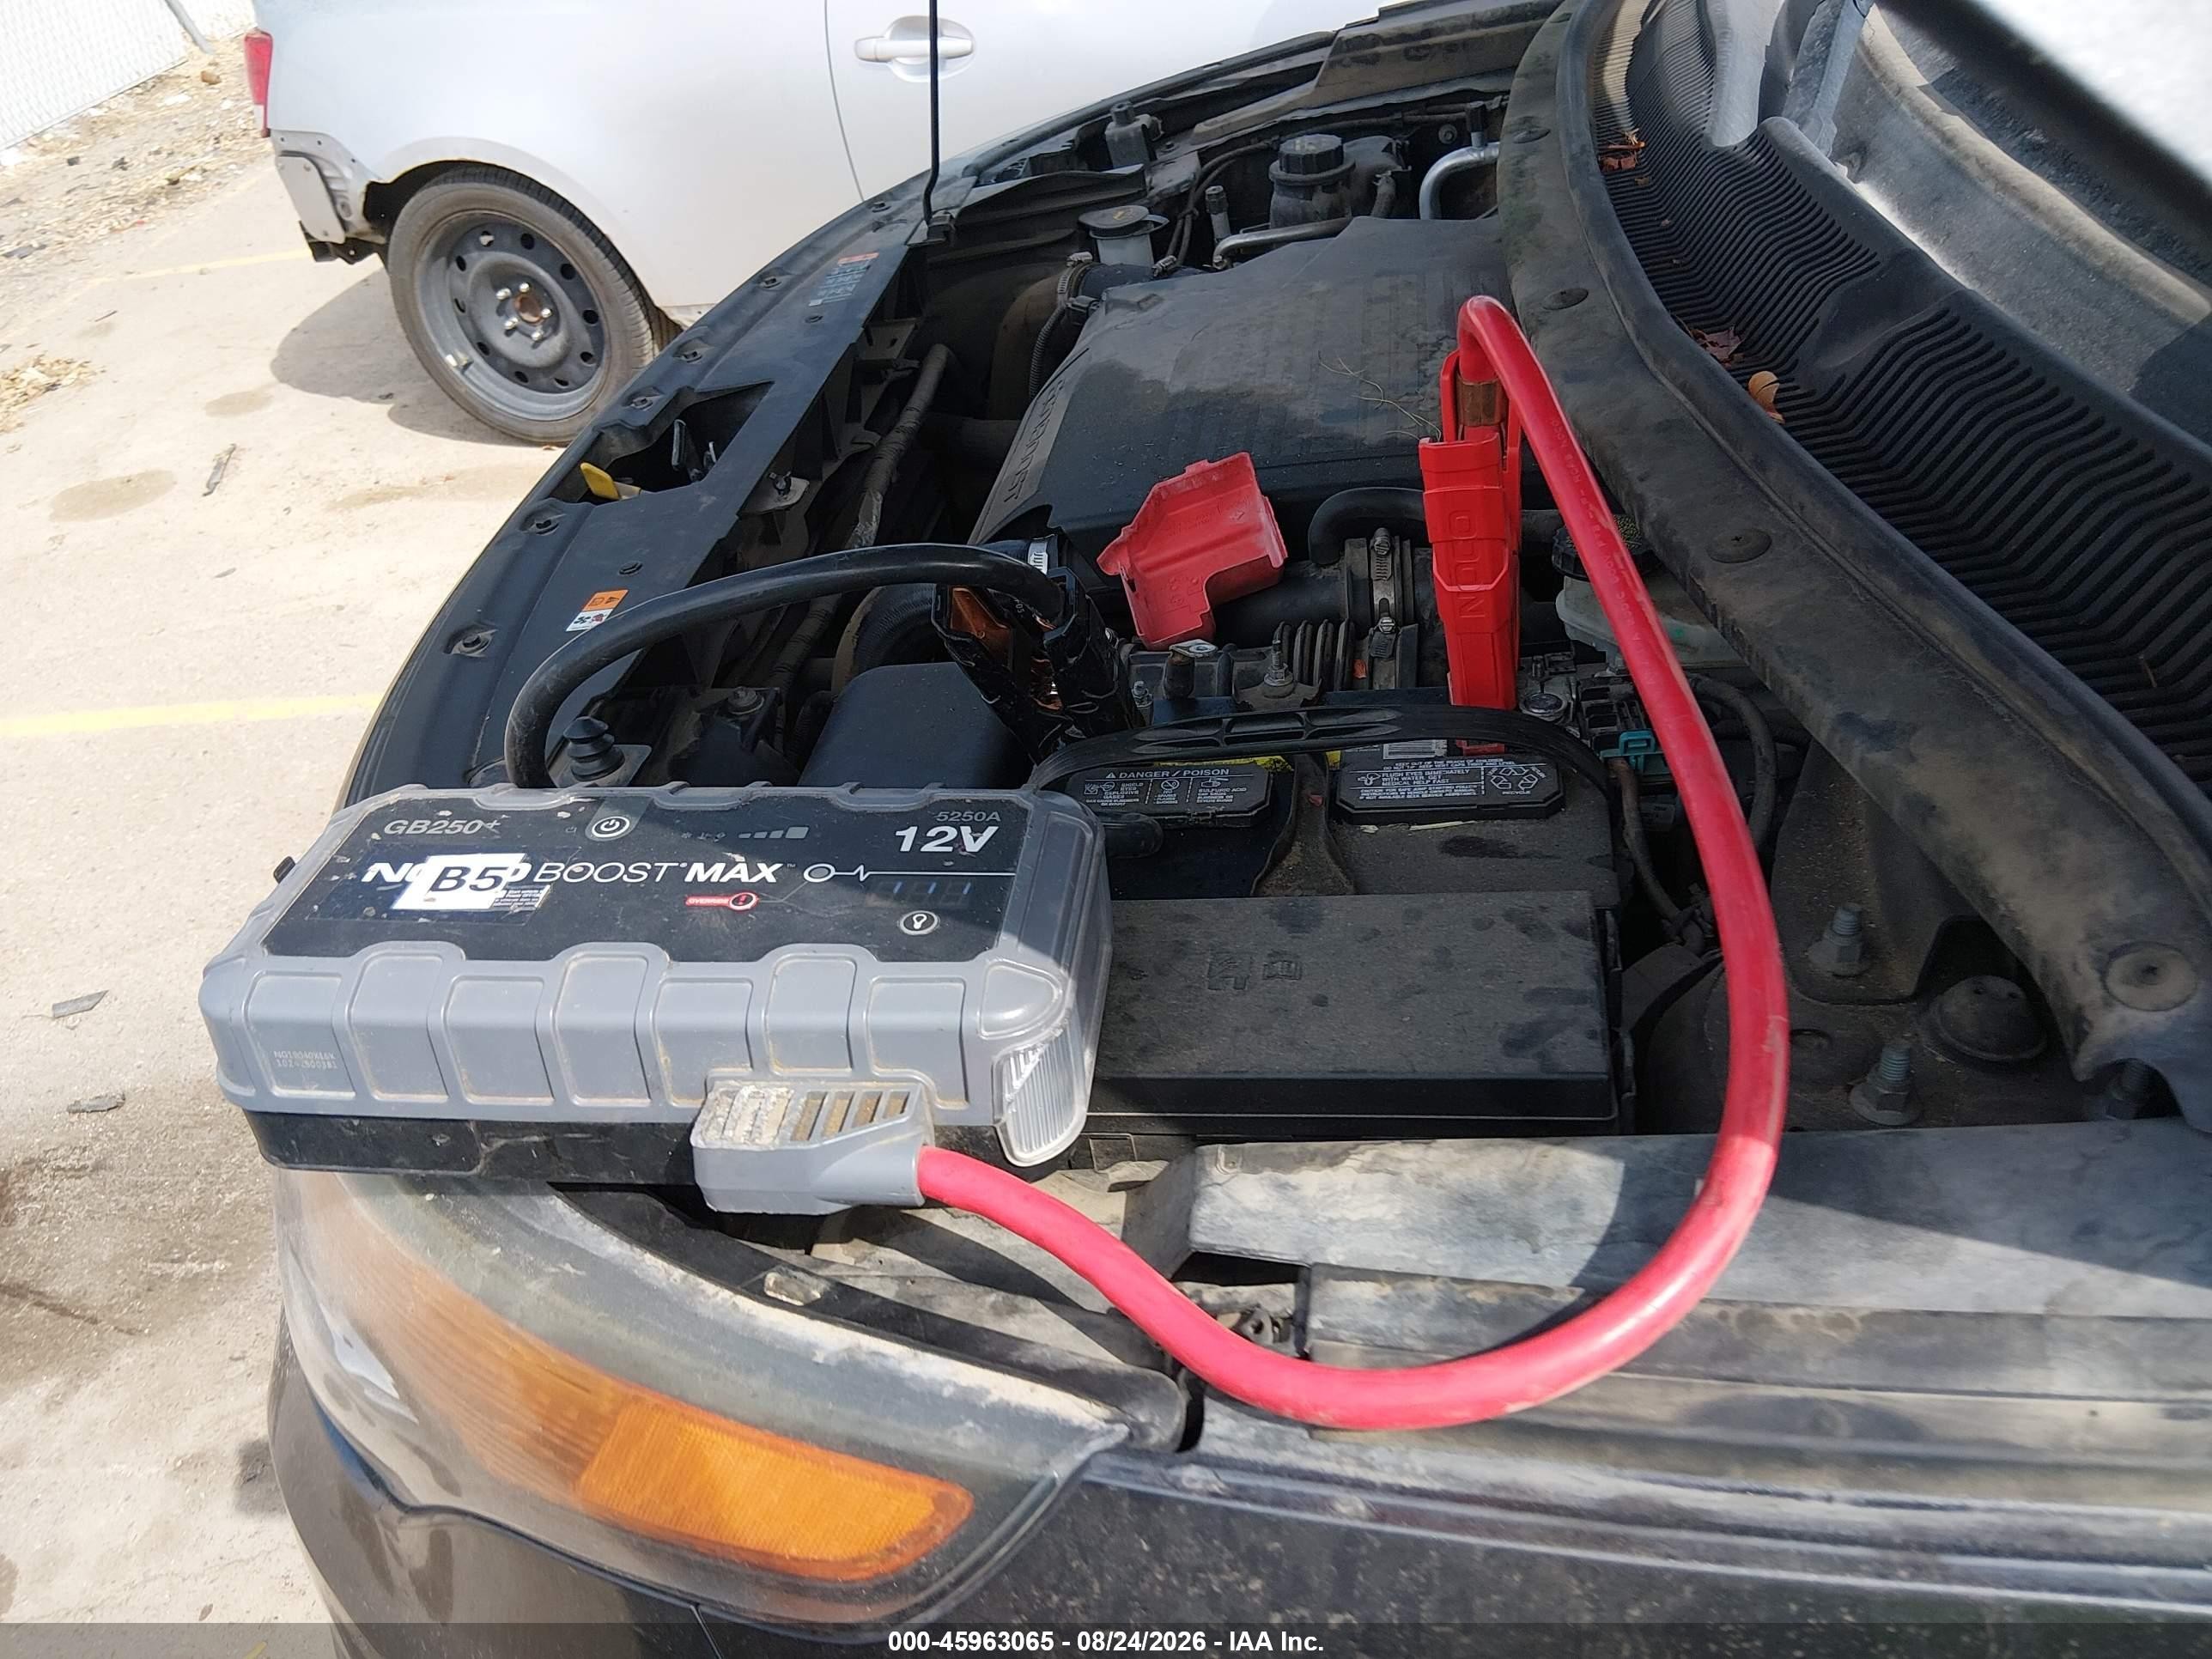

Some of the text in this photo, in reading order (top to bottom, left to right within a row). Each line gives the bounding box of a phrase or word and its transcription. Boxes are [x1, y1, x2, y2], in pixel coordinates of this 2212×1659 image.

[1119, 770, 1170, 779] DANGER
[936, 811, 1001, 823] 5250A
[894, 825, 999, 853] 12V
[429, 866, 510, 892] B5
[534, 861, 680, 883] BOOST
[684, 862, 785, 883] MAX
